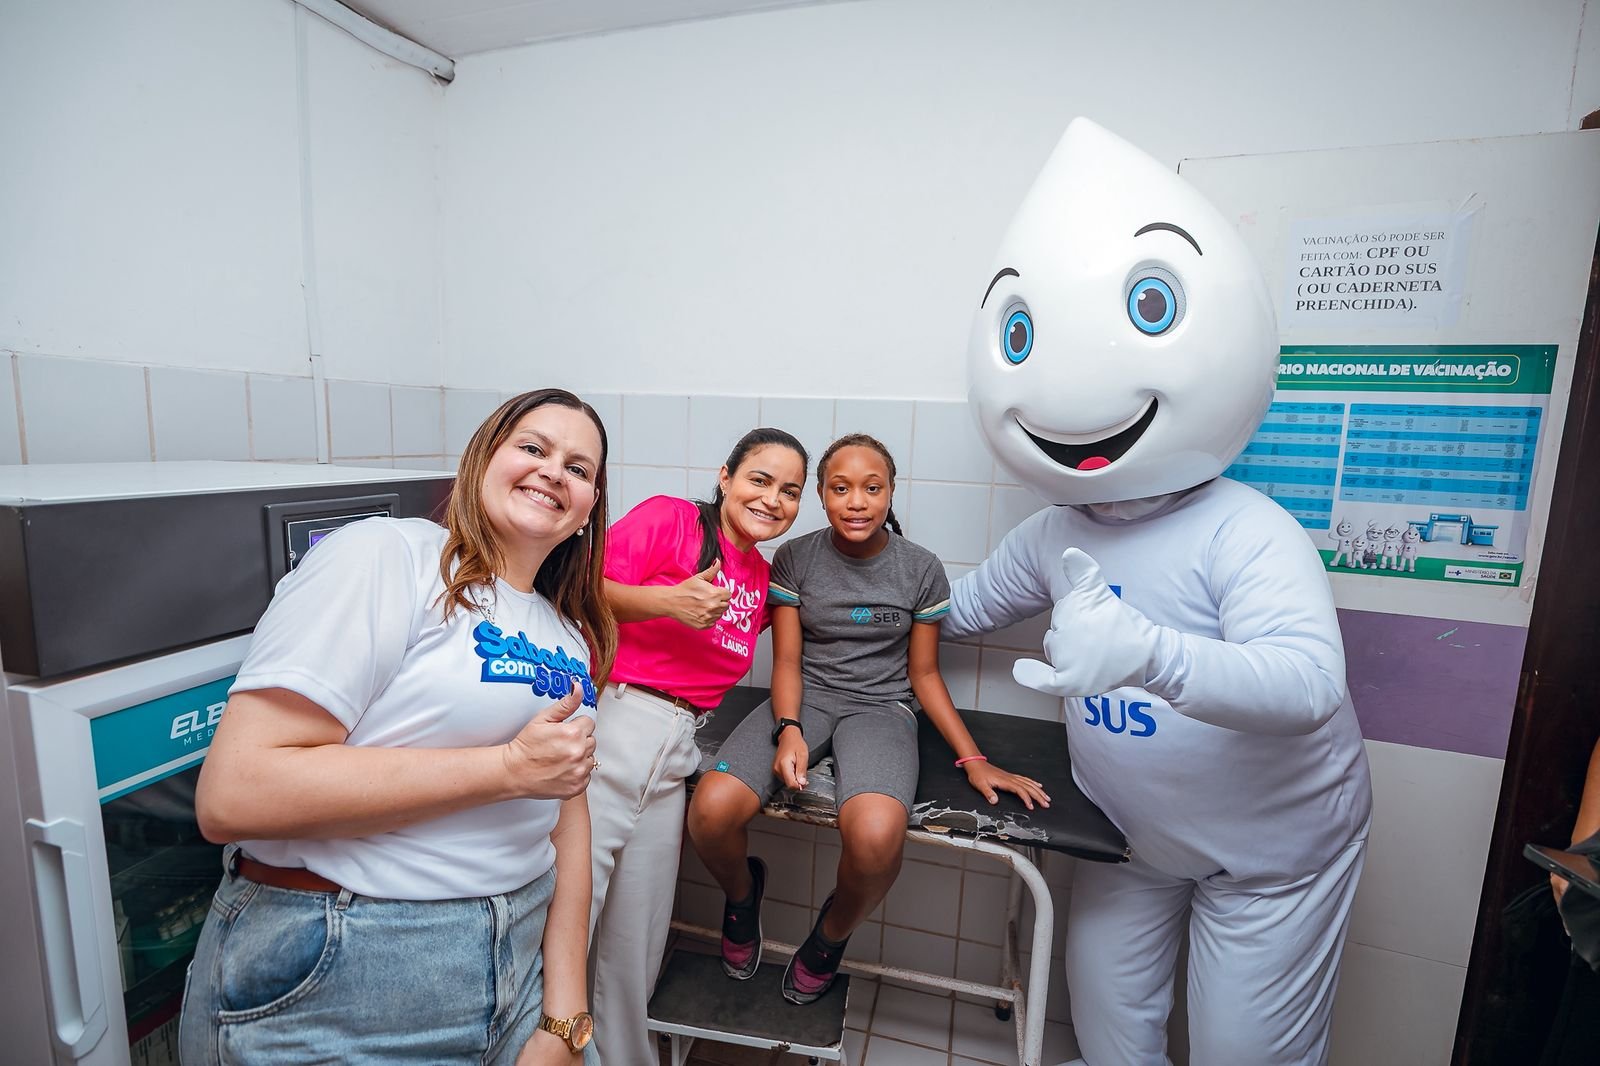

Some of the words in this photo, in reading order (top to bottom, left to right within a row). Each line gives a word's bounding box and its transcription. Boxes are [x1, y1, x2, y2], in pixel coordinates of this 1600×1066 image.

[1303, 234, 1369, 245] VACINAÇÃO
[1371, 232, 1387, 243] SÓ
[1389, 232, 1421, 242] PODE
[1423, 231, 1445, 241] SER
[1301, 252, 1331, 261] FEITA
[1333, 251, 1362, 261] COM:
[1366, 247, 1400, 259] CPF
[1404, 245, 1430, 257] OU
[1299, 263, 1370, 278] CARTÃO
[1375, 264, 1400, 276] DO
[1405, 263, 1437, 275] SUS
[1307, 282, 1331, 295] OU
[1336, 280, 1442, 294] CADERNETA
[1296, 298, 1417, 312] PREENCHIDA).
[1306, 363, 1387, 376] NACIONAL
[1389, 363, 1410, 376] DE
[1413, 361, 1511, 381] VACINAÇÃO
[873, 611, 901, 623] SEB
[721, 635, 749, 657] LAURO
[490, 659, 536, 678] com
[1084, 694, 1157, 738] SUS
[183, 728, 214, 747] MED
